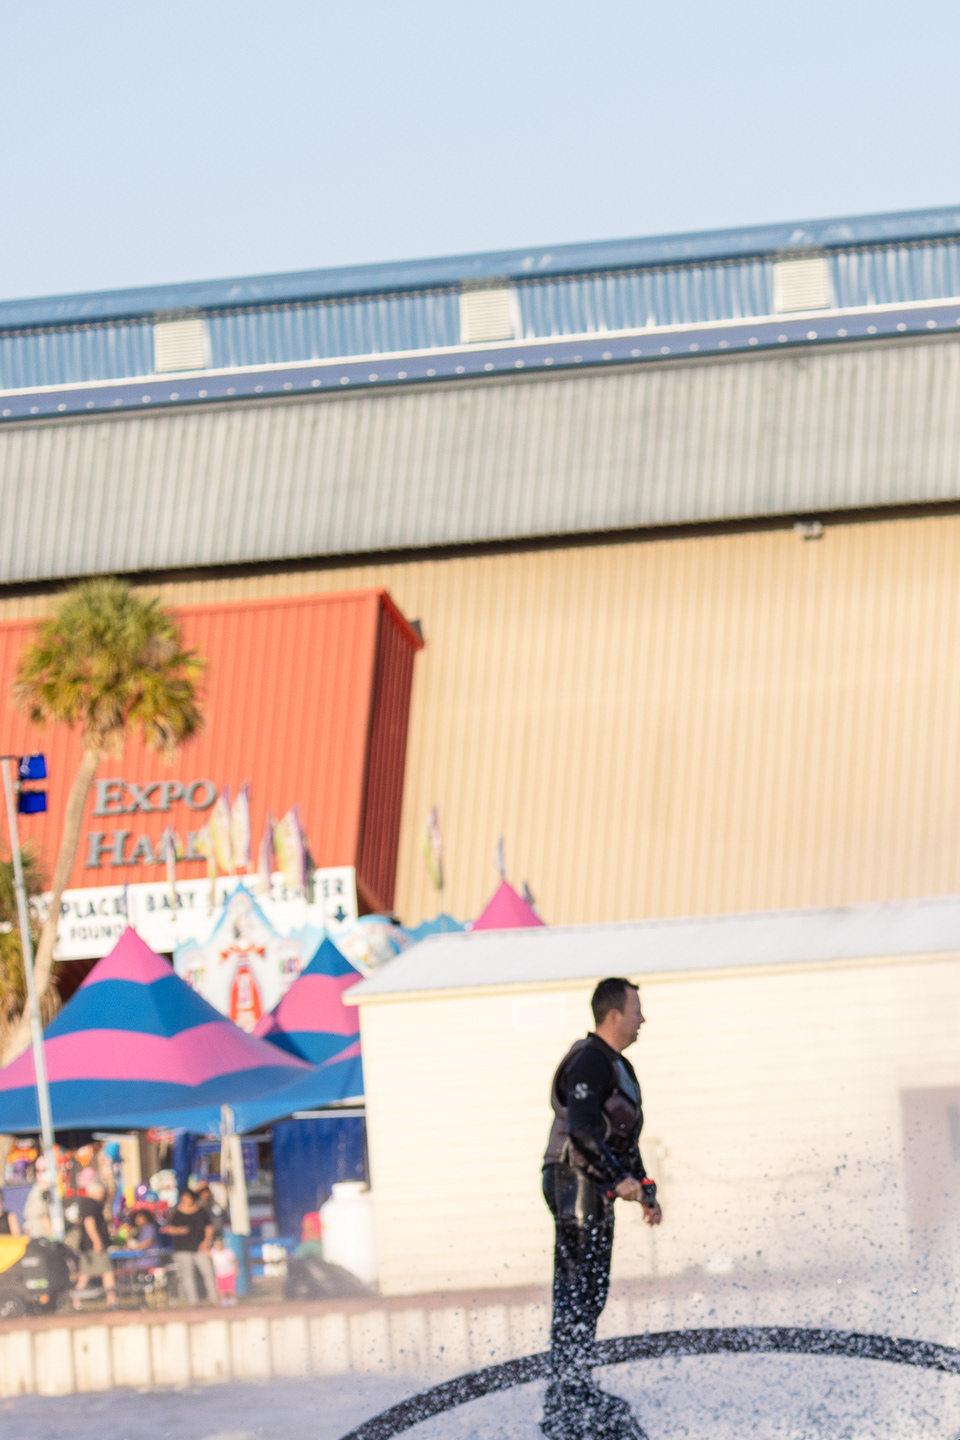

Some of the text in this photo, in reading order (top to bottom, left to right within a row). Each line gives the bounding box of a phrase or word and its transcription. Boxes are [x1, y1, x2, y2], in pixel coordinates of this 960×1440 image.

[91, 777, 218, 817] EXPO
[60, 896, 127, 919] PLACE
[146, 891, 195, 913] BABY
[268, 877, 343, 903] CENER
